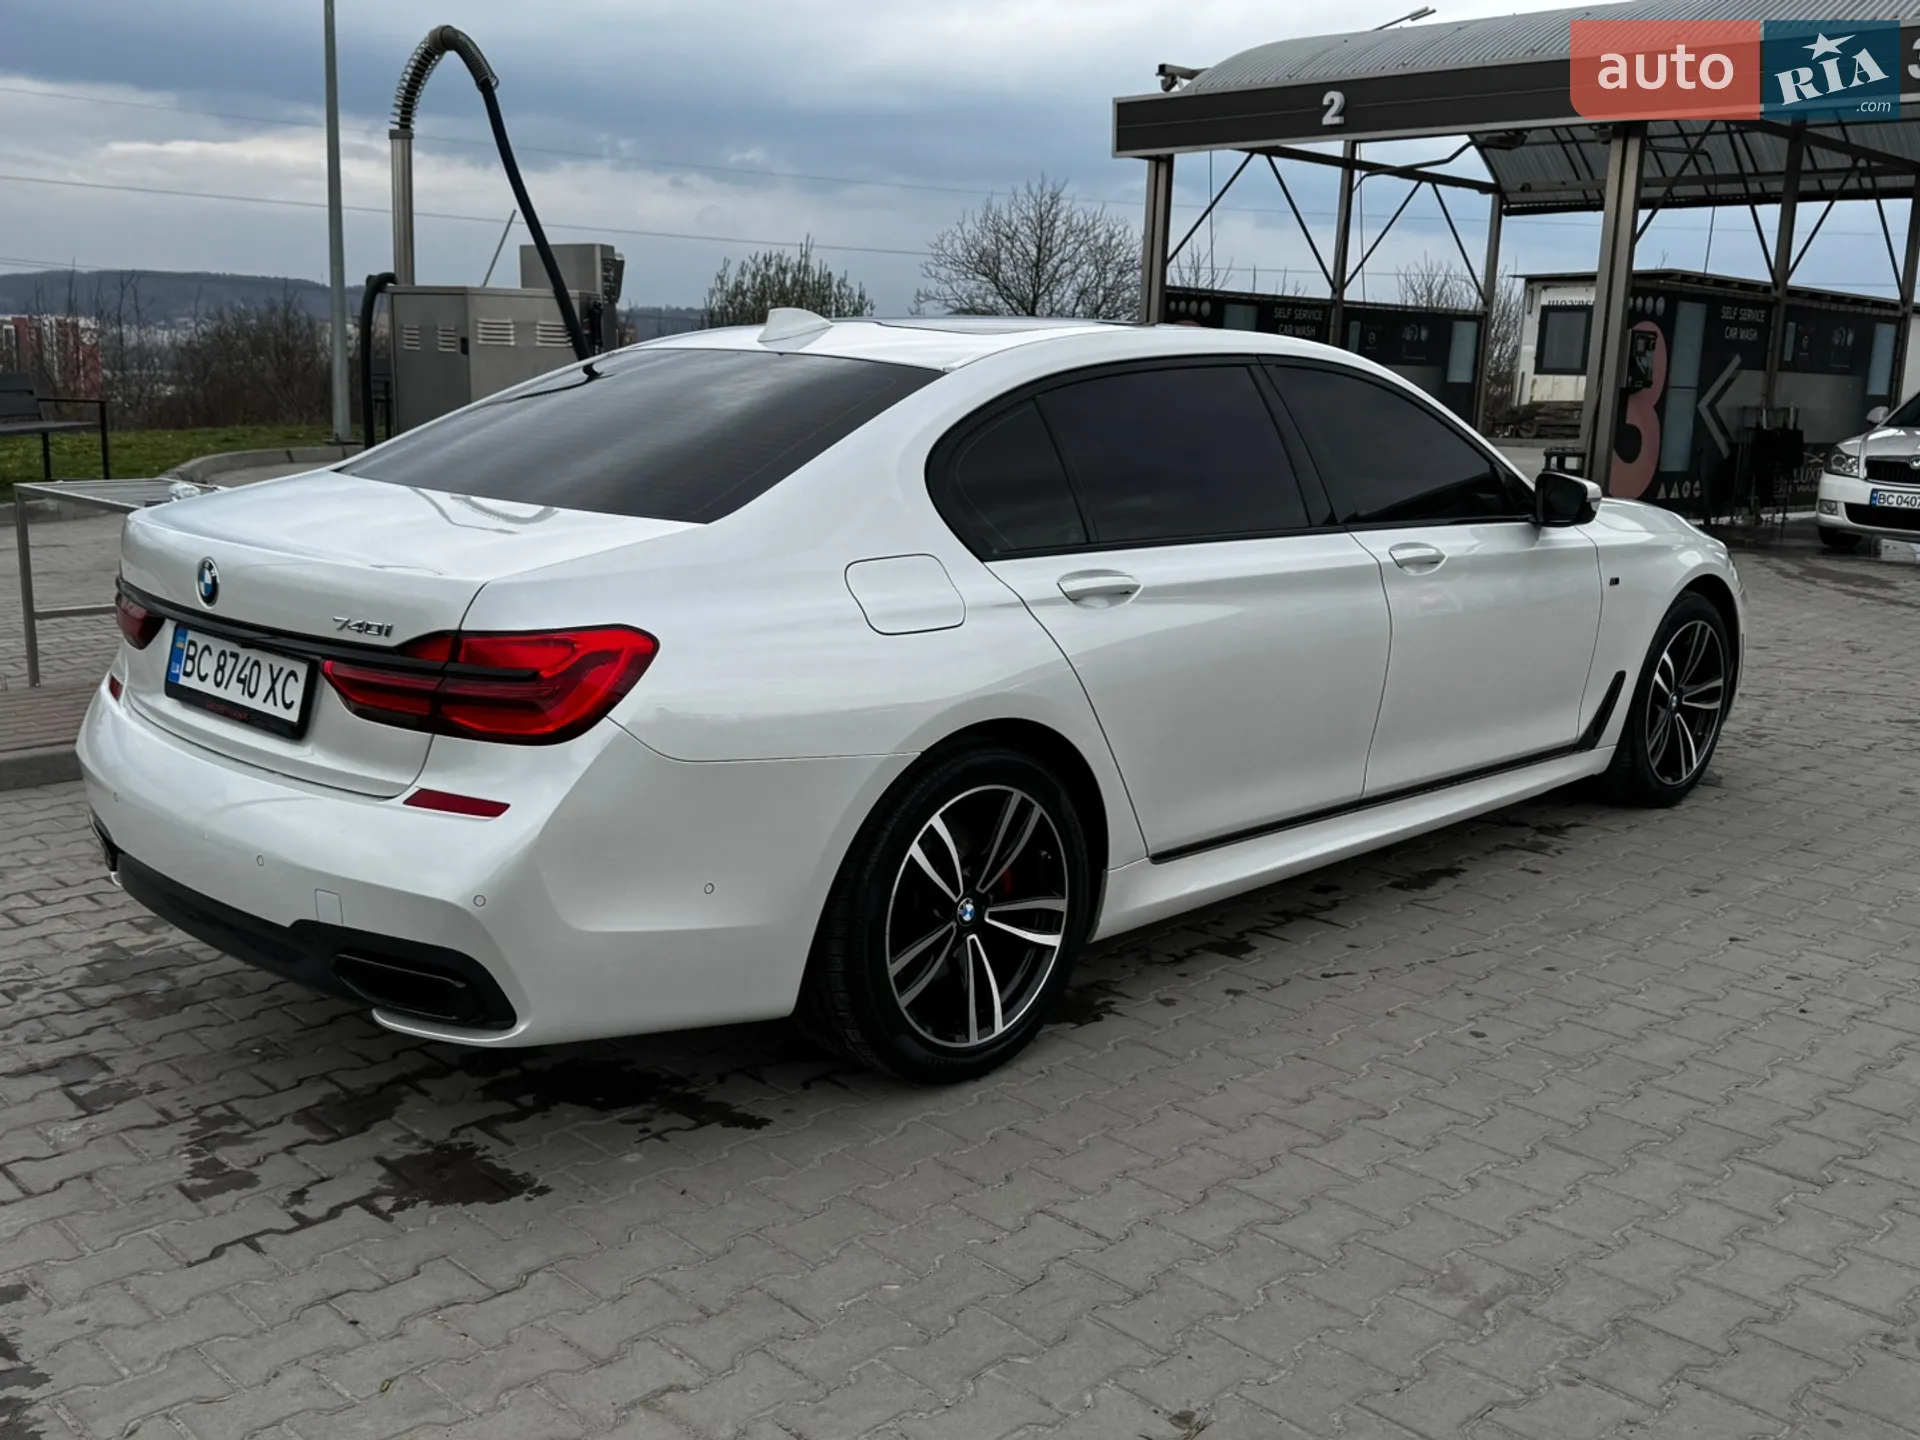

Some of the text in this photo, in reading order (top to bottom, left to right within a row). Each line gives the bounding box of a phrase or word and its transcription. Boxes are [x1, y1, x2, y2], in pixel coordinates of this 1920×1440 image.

[1322, 90, 1346, 126] 2
[1273, 306, 1324, 322] SELF SERVICE
[1721, 305, 1767, 323] SELF SERVICE
[1278, 323, 1317, 337] CAR WASH
[1724, 325, 1759, 341] CAR WASH
[1878, 493, 1895, 505] BC
[332, 616, 394, 637] 740i
[182, 639, 212, 682] BC
[213, 649, 262, 699] 8740
[262, 662, 299, 711] XC
